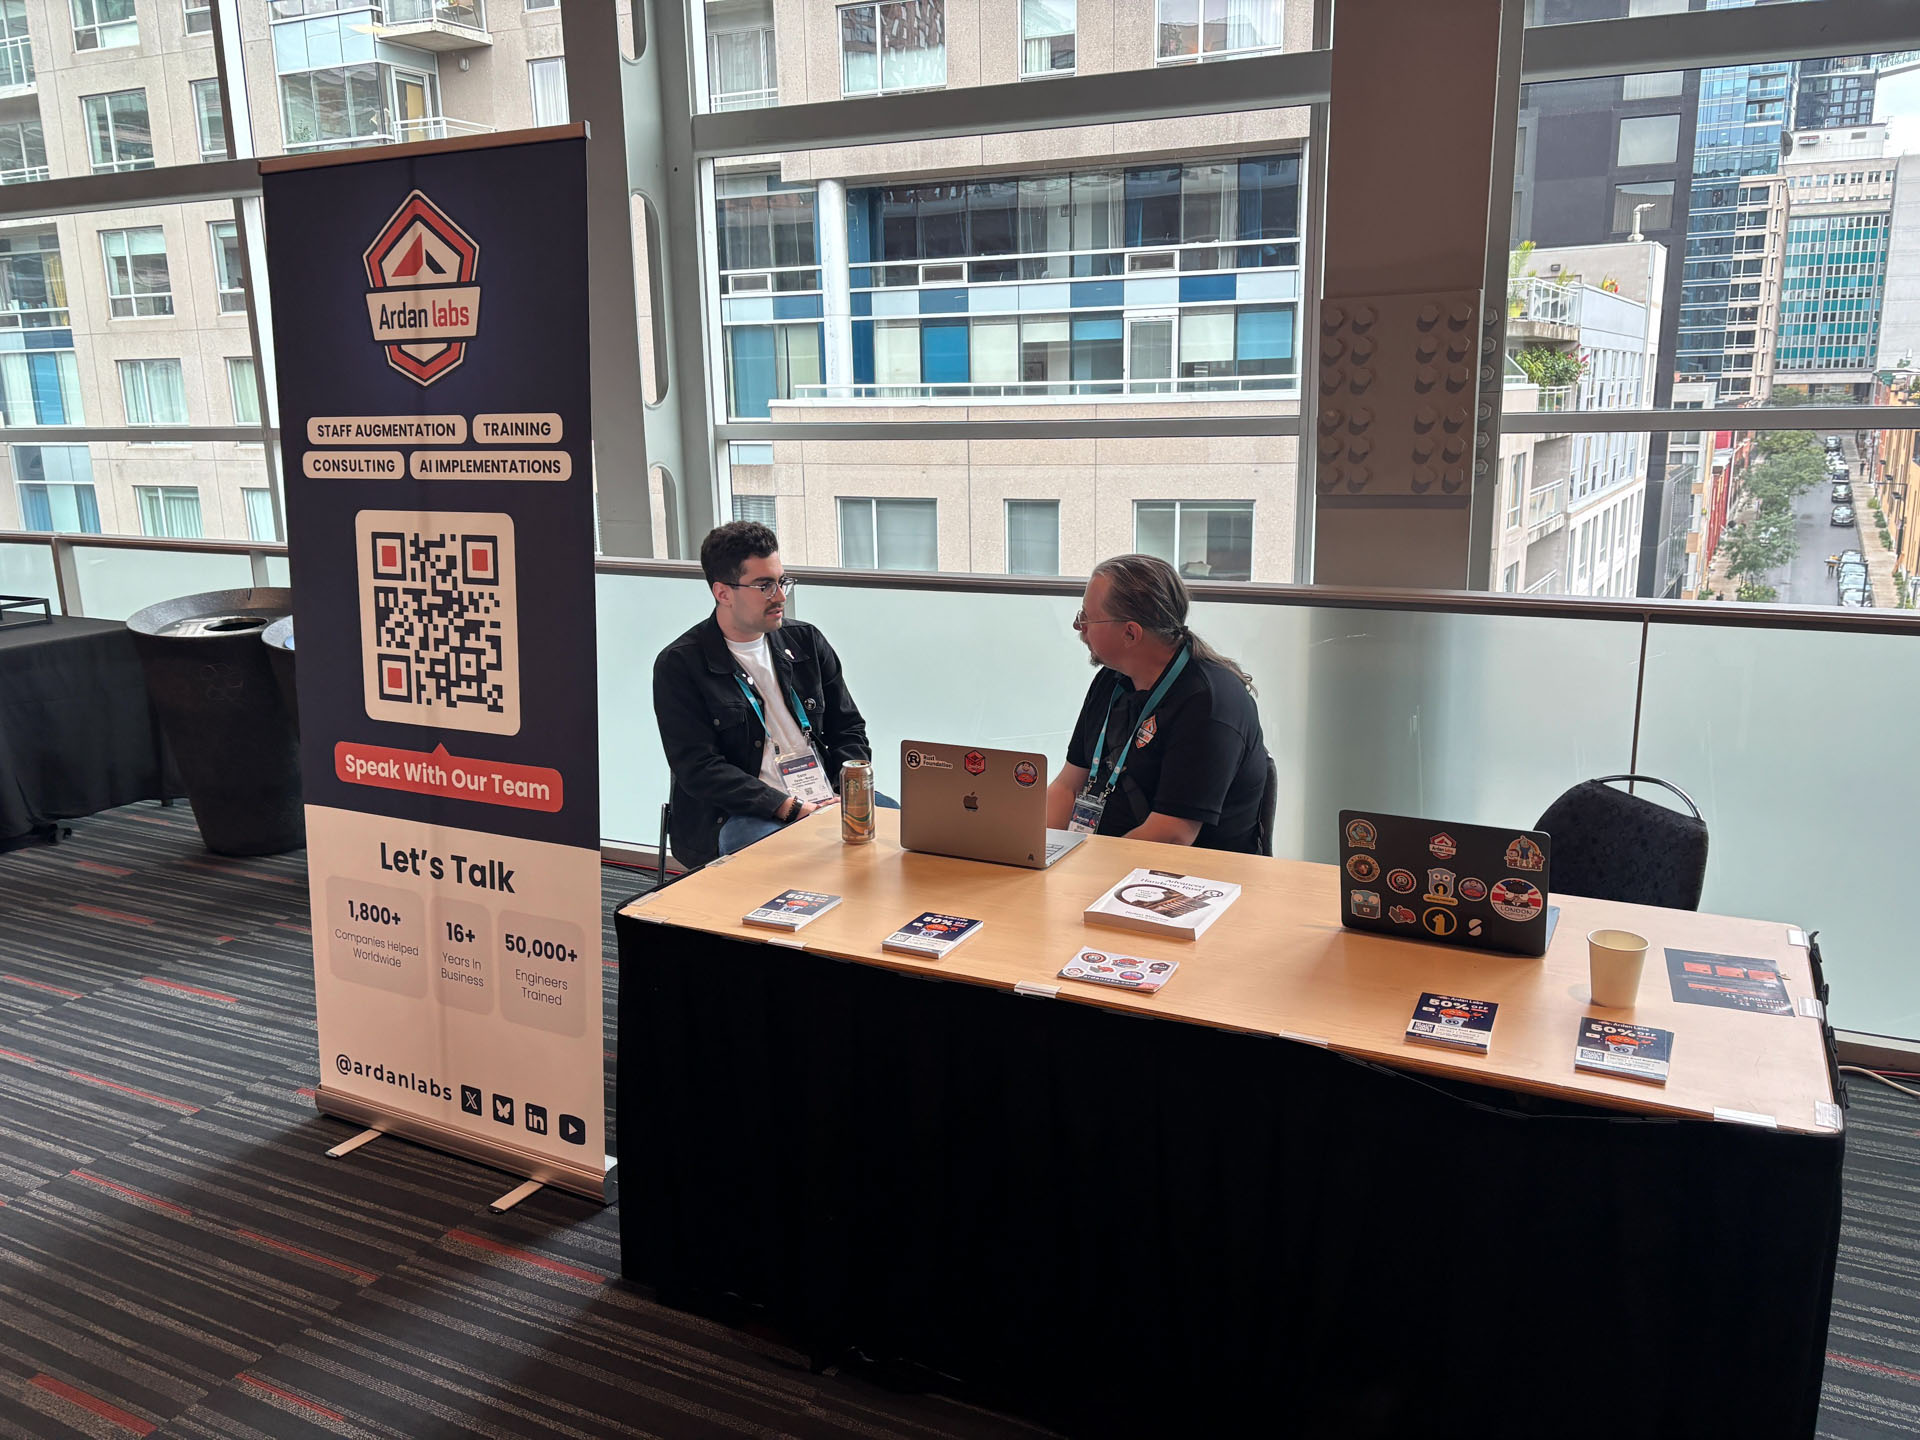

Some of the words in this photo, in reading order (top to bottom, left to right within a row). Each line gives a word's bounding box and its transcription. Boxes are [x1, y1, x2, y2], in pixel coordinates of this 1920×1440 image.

[379, 302, 428, 330] Ardan
[432, 299, 469, 327] labs
[317, 424, 352, 437] STAFF
[355, 423, 456, 437] AUGMENTATION
[483, 422, 552, 436] TRAINING
[313, 459, 395, 473] CONSULTING
[419, 459, 433, 473] AI
[435, 459, 561, 474] IMPLEMENTATIONS
[345, 754, 400, 780] Speak
[403, 762, 447, 786] With
[451, 769, 487, 791] Our
[491, 774, 550, 801] Team
[380, 842, 444, 880] Let's
[450, 855, 515, 893] Talk
[348, 900, 401, 926] 1,800+
[1500, 906, 1532, 915] LONDON
[335, 928, 386, 950] Companies
[387, 941, 419, 958] Helped
[446, 922, 476, 943] 16+
[353, 947, 402, 968] Worldwide
[505, 933, 578, 963] 50,000+
[442, 952, 470, 969] Years
[472, 958, 482, 970] In
[441, 967, 484, 988] Business
[515, 969, 568, 990] Engineers
[521, 986, 562, 1006] Trained
[1429, 998, 1470, 1011] 50%
[1591, 1023, 1636, 1037] 50%
[336, 1053, 452, 1101] @ardanlabs
